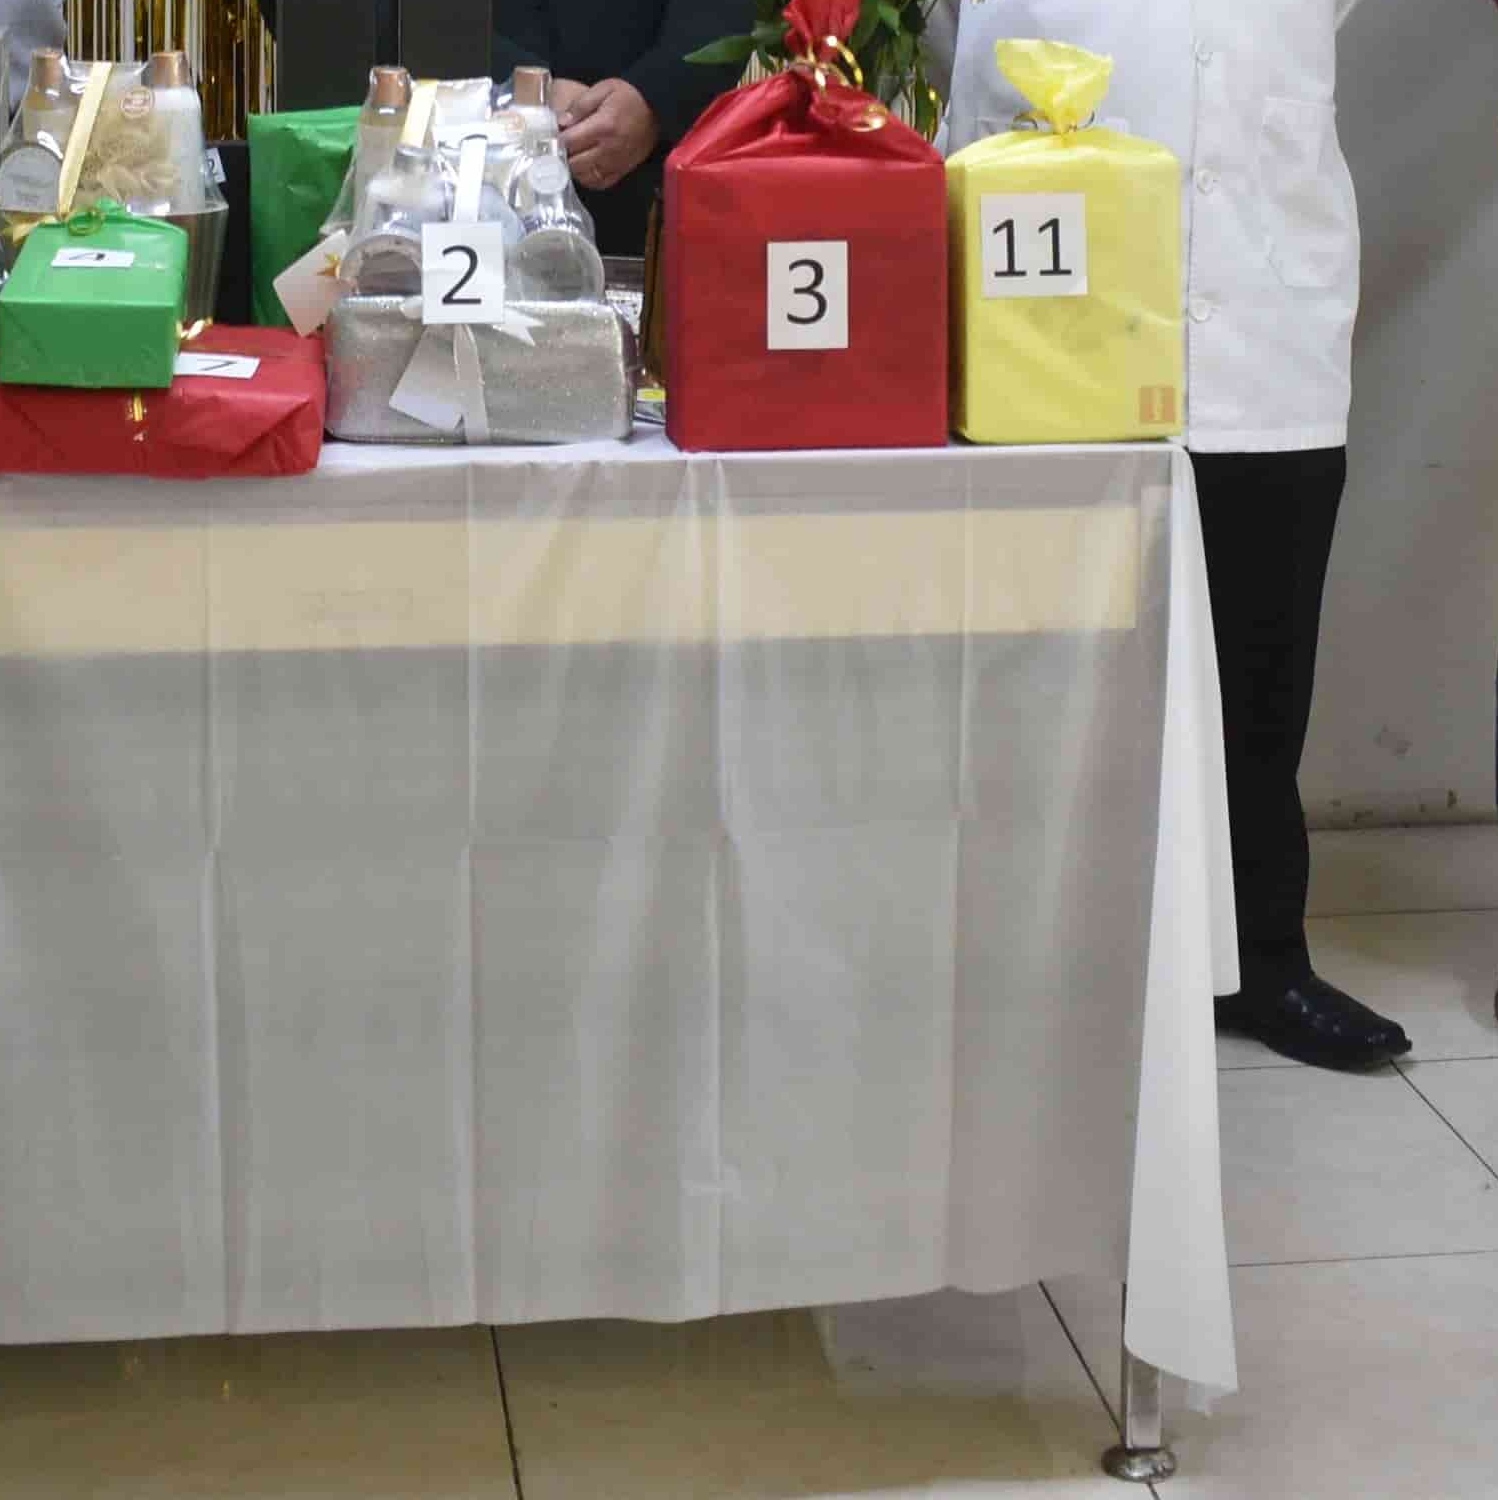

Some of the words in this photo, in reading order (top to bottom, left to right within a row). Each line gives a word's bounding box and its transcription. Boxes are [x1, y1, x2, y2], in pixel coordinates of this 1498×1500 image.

[441, 245, 482, 305] 2
[992, 218, 1072, 277] 11
[786, 258, 828, 325] 3
